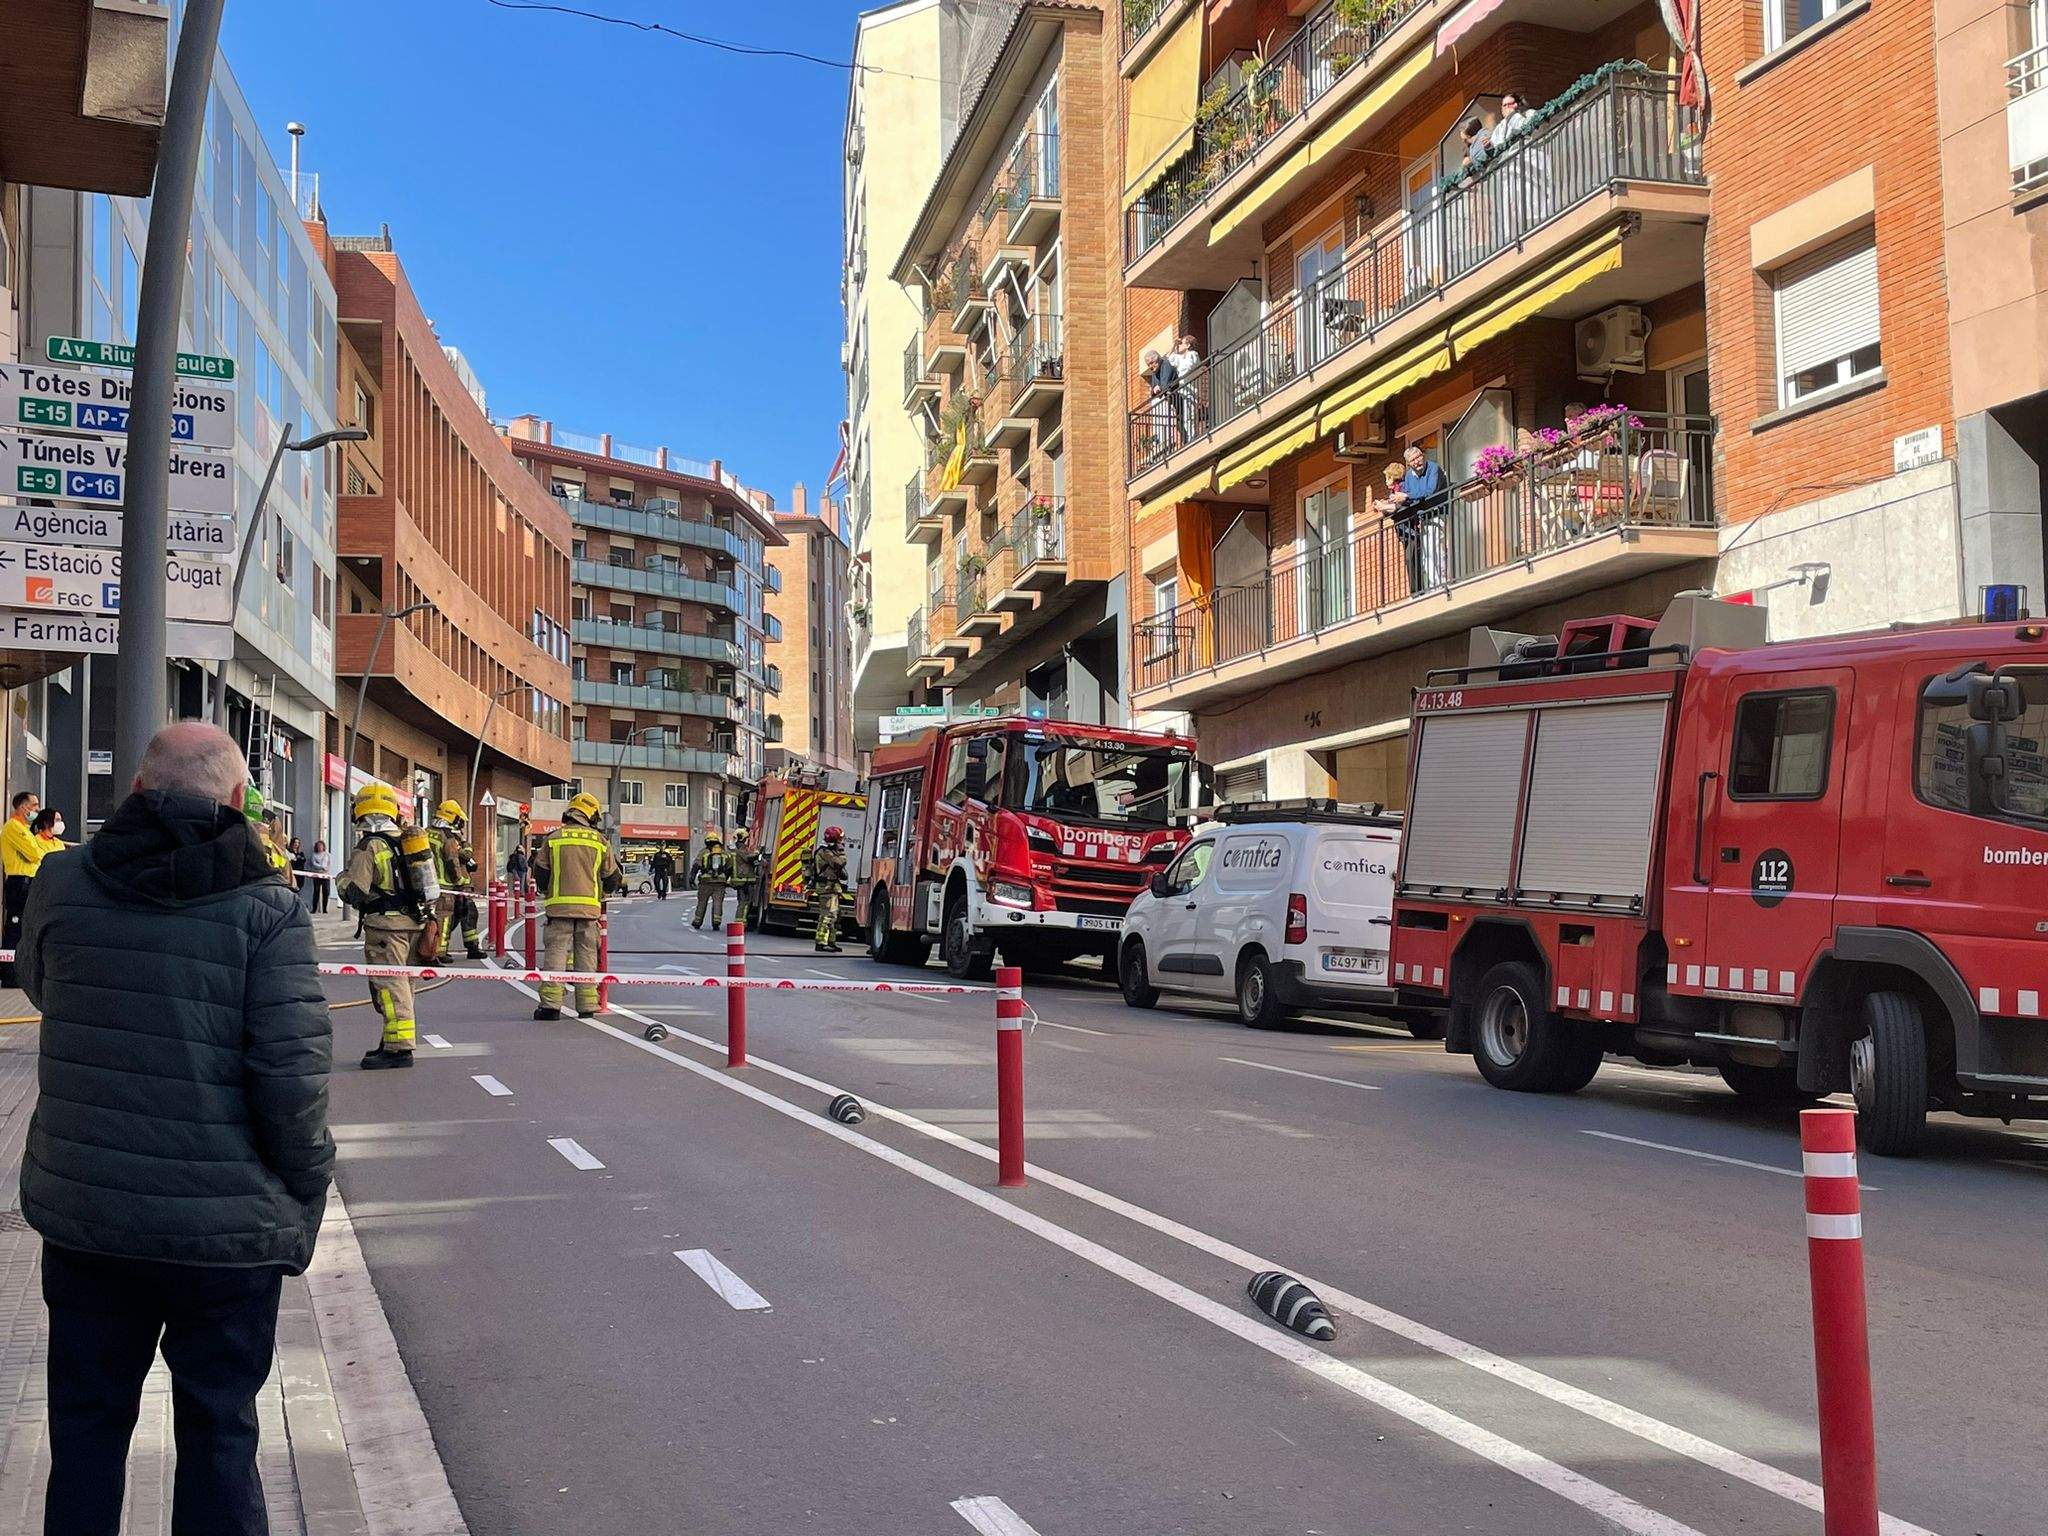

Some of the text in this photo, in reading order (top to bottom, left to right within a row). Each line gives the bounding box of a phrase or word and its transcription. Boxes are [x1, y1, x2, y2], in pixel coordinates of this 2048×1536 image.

[59, 339, 91, 359] Av.
[177, 357, 225, 374] aulet
[19, 368, 226, 412] Totes Dirions
[23, 401, 67, 422] E-15
[81, 408, 130, 428] AP-7
[18, 438, 95, 466] Túnels
[22, 470, 116, 496] E-9 C-16
[14, 510, 108, 538] Agència
[25, 548, 102, 575] Estació
[166, 561, 222, 589] Cugat
[58, 592, 93, 607] FGC
[1420, 691, 1463, 711] 4.13.48
[1064, 826, 1142, 849] bombers
[1223, 839, 1282, 868] comfica
[1323, 858, 1386, 875] comfica
[1759, 860, 1789, 882] 112
[1330, 955, 1381, 971] 6497 MFT
